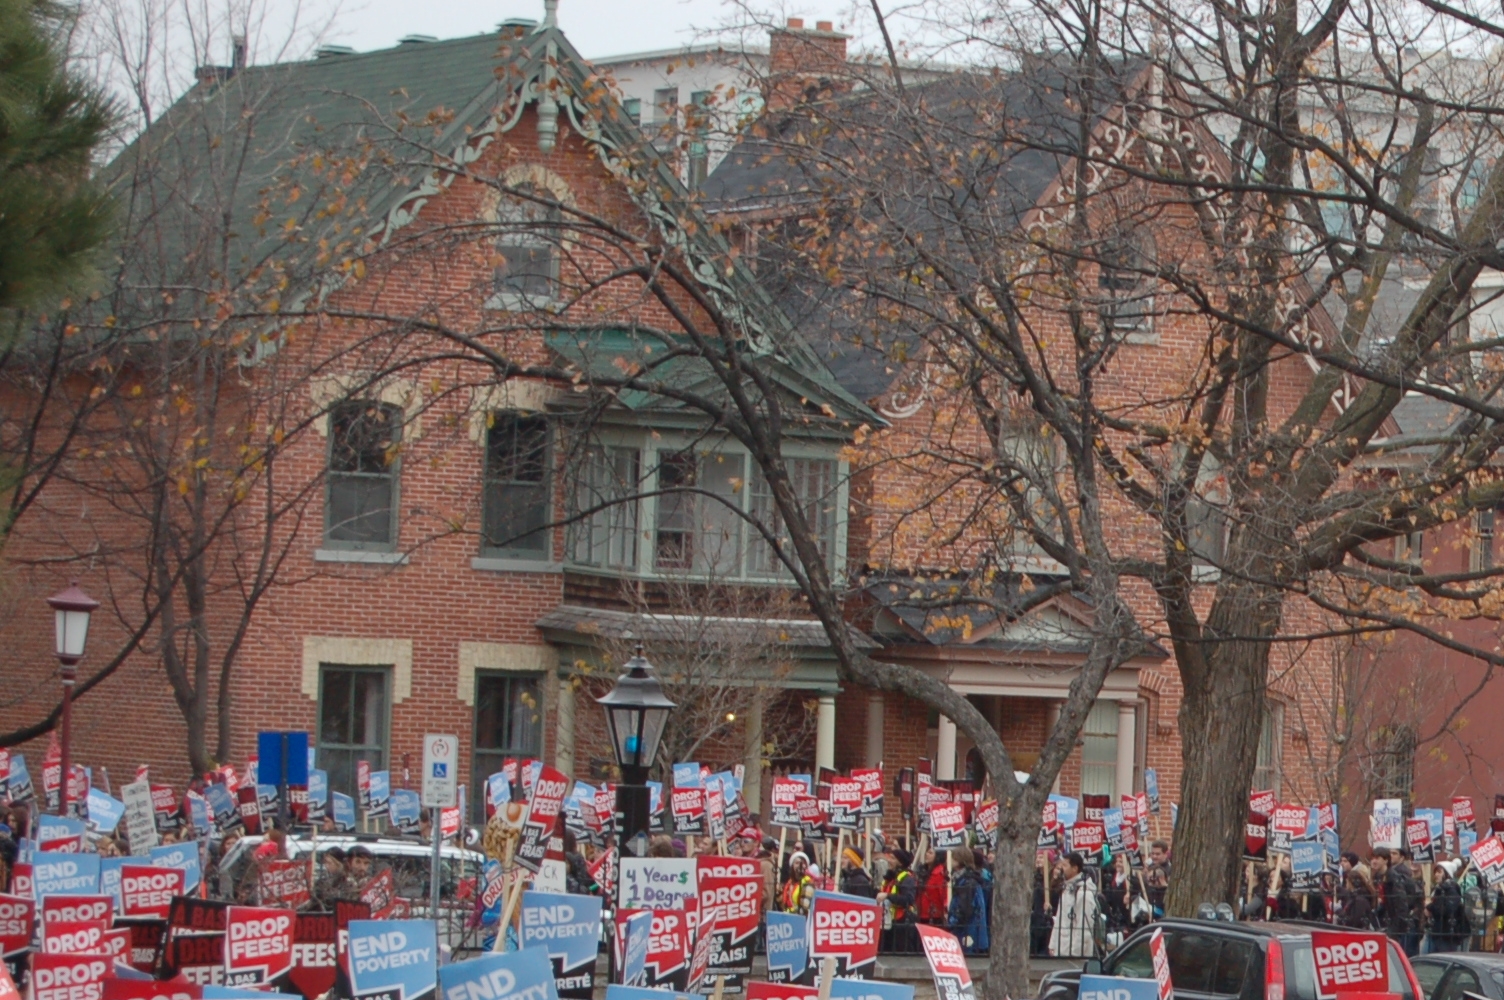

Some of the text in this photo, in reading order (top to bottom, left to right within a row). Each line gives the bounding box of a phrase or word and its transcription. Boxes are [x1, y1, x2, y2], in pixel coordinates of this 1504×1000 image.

[537, 780, 566, 796] DROP
[532, 798, 560, 815] FEES!
[36, 860, 78, 880] END
[626, 869, 636, 883] 4
[37, 876, 96, 892] POVERTY
[123, 873, 179, 891] DROP
[629, 884, 640, 902] 1
[816, 910, 876, 929] DROP
[767, 921, 792, 939] END
[816, 927, 874, 946] FEES!
[1319, 962, 1383, 986] FEES!
